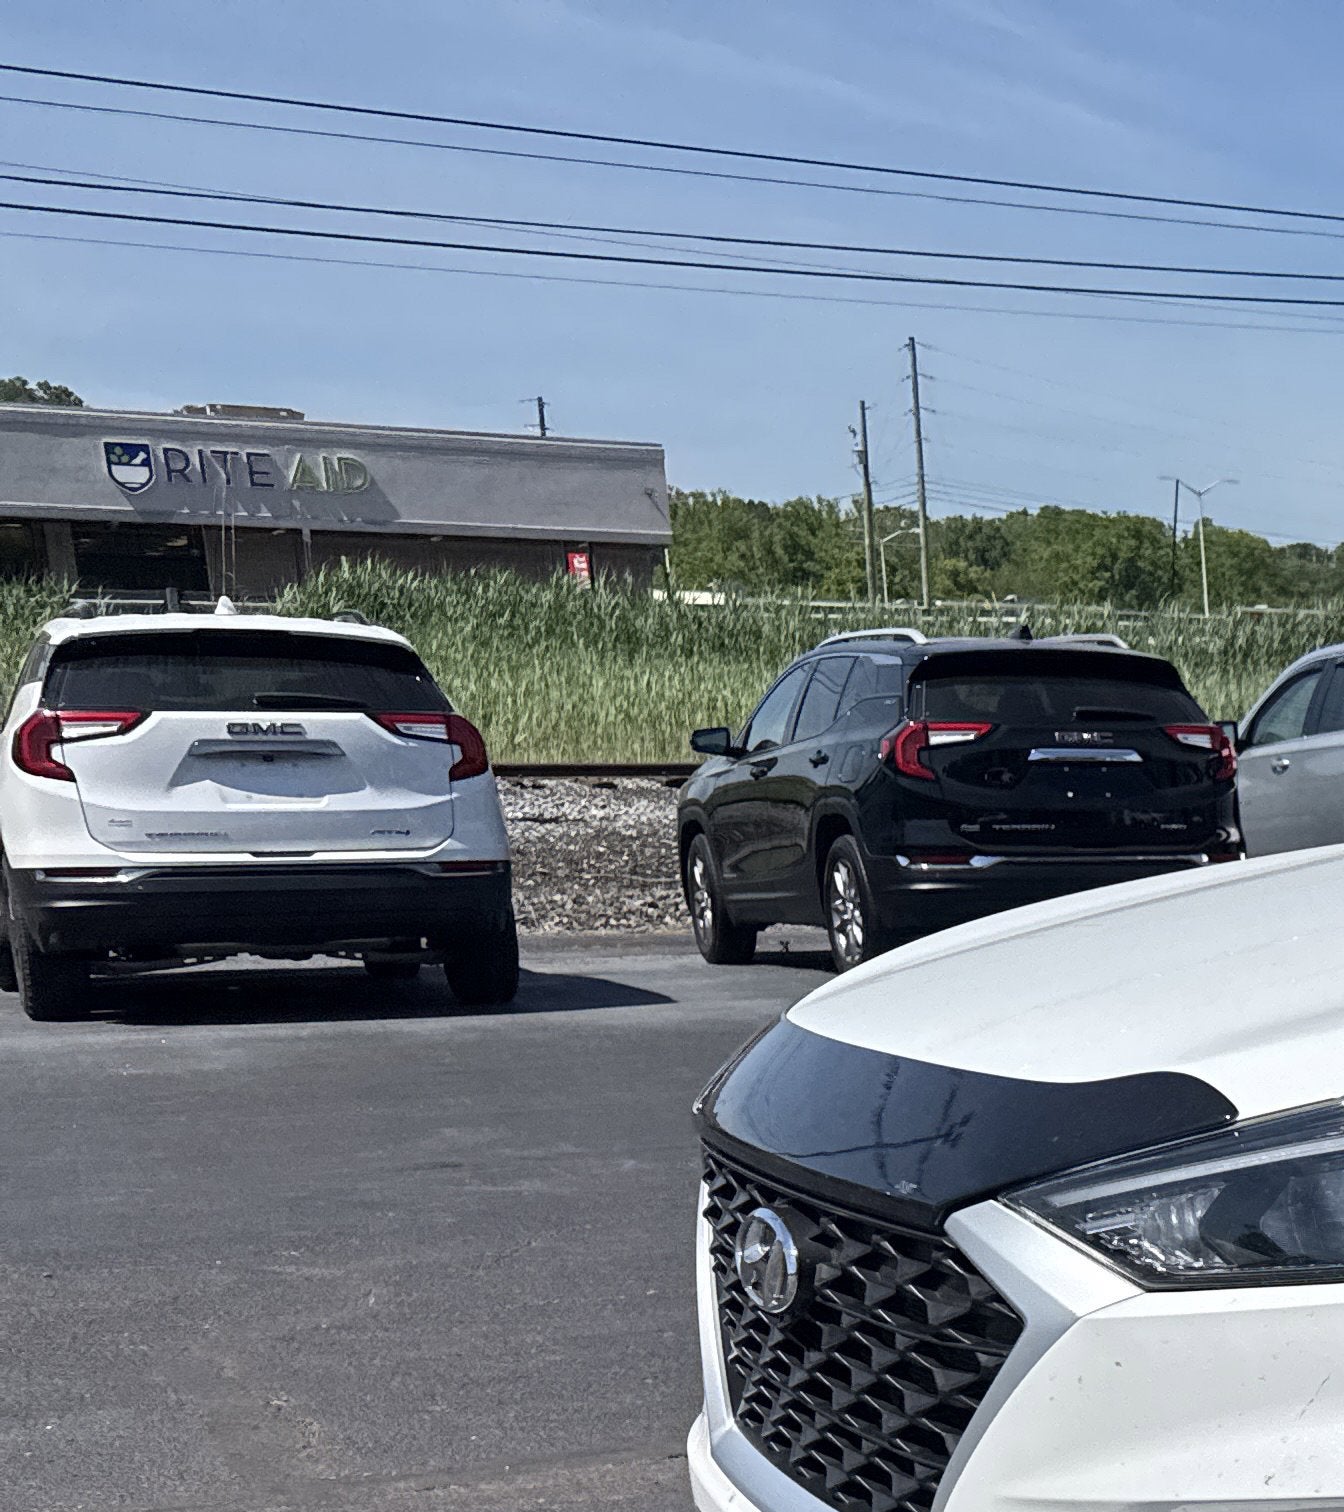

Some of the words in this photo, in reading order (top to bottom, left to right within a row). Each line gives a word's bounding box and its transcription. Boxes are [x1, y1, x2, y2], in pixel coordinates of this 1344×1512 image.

[161, 446, 275, 488] RITE
[289, 452, 370, 493] AID
[226, 722, 307, 736] GMC
